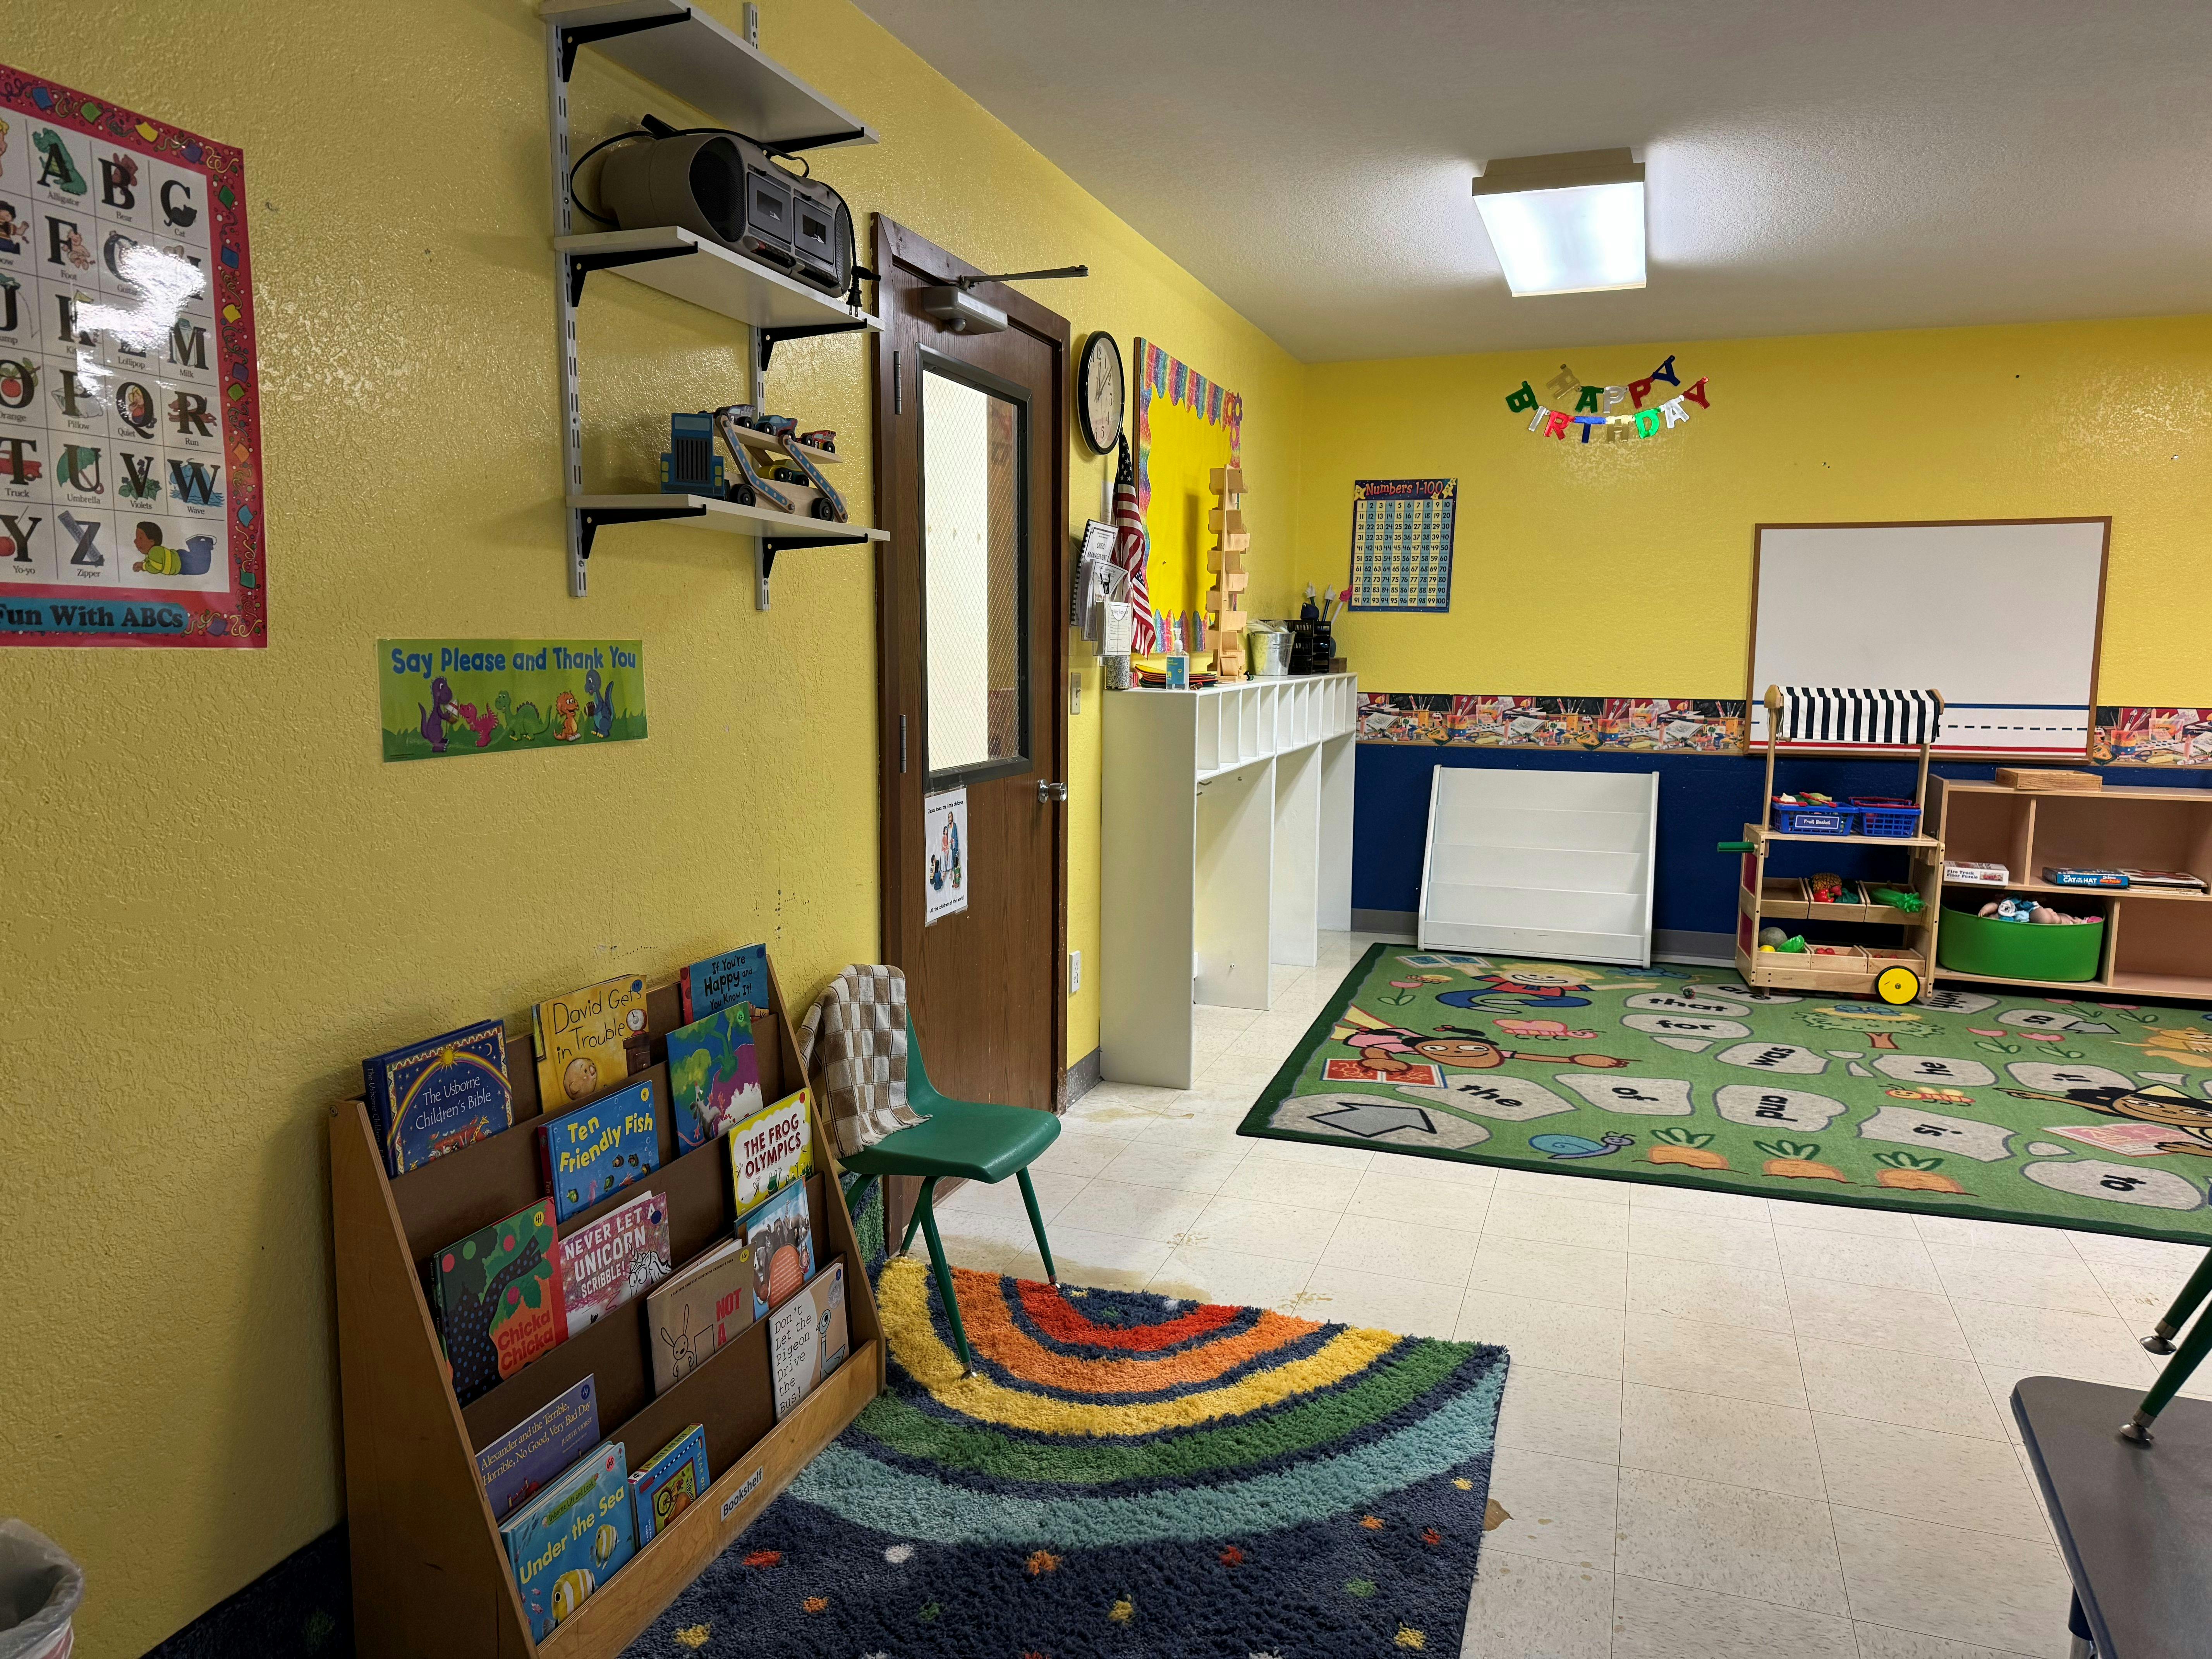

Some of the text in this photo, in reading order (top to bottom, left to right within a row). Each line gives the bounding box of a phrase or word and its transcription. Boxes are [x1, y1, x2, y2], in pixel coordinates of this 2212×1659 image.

[37, 143, 73, 187] A
[48, 191, 80, 206] Alligator
[98, 158, 135, 210] B
[116, 211, 132, 222] Bear
[160, 179, 191, 227] C
[45, 215, 77, 266] F
[175, 228, 185, 237] Cat
[61, 270, 77, 280] Foot
[167, 323, 209, 370] M
[1097, 345, 1102, 361] 12
[118, 356, 146, 369] Lollipop
[180, 369, 194, 378] Milk
[59, 369, 93, 416] P
[1546, 355, 1681, 414] HAPPY
[117, 382, 155, 440] Q
[174, 391, 214, 438] R
[1106, 411, 1109, 425] 4
[1505, 376, 1710, 444] BIRTHDAY
[68, 420, 89, 430] Pillow
[118, 428, 136, 438] Quiet
[1101, 426, 1104, 439] 5
[185, 438, 199, 447] Run
[0, 437, 37, 486] T
[64, 444, 101, 491] U
[120, 452, 154, 498] V
[788, 472, 792, 480] 2
[5, 488, 29, 498] Truck
[167, 459, 221, 504] W
[1365, 481, 1443, 496] Numbers 1-100
[67, 493, 101, 505] Umbrella
[130, 500, 153, 510] Violets
[187, 506, 205, 515] Wave
[0, 514, 42, 562] Y
[70, 520, 101, 565] Z
[13, 565, 35, 575] Yo-yo
[77, 568, 101, 578] Zipper
[50, 604, 184, 629] With ABCs
[391, 645, 636, 679] Say Please and Thank You
[712, 955, 746, 975] If You're
[704, 967, 752, 997] Happy and
[1717, 986, 1772, 1001] are
[709, 983, 752, 1011] You Know It!
[1648, 997, 1728, 1013] that
[553, 991, 603, 1035] David
[1655, 1020, 1716, 1032] for
[569, 1017, 625, 1050] Trouble
[556, 1046, 572, 1064] in
[1747, 1046, 1796, 1067] was
[1914, 1061, 1955, 1076] he
[422, 1075, 480, 1106] The Usborne
[2052, 1072, 2094, 1082] it
[415, 1088, 491, 1130] Children's Bible
[1456, 1084, 1523, 1108] the
[1611, 1087, 1659, 1103] of
[1755, 1094, 1798, 1123] and
[558, 1112, 654, 1174] Friendly Fish
[567, 1115, 600, 1144] Ten
[744, 1112, 799, 1160] THE FROG
[1913, 1123, 1963, 1136] is
[744, 1132, 802, 1179] OLYMPICS
[2100, 1174, 2147, 1192] to
[565, 1225, 611, 1261] NEVER
[617, 1209, 642, 1234] LET
[574, 1226, 647, 1283] UNICORN
[581, 1262, 626, 1299] SCRIBBLE!
[716, 1288, 742, 1319] NOT
[498, 1309, 551, 1351] Chicka
[775, 1305, 803, 1333] Don't
[776, 1314, 812, 1351] Let the
[500, 1326, 554, 1371] Chicka
[718, 1322, 726, 1346] A
[776, 1332, 811, 1367] Pigeon
[777, 1350, 806, 1382] Drive
[779, 1377, 796, 1397] the
[779, 1386, 802, 1415] Bus!
[481, 1402, 569, 1471] Alexander and the Terrible,
[482, 1459, 515, 1486] Horrible,
[515, 1448, 527, 1463] No
[528, 1432, 549, 1453] Good,
[549, 1421, 564, 1436] Very
[565, 1409, 577, 1426] Bad
[578, 1401, 591, 1417] Day
[562, 1429, 577, 1446] JUDITH
[549, 1504, 567, 1522] Usborne
[567, 1496, 575, 1507] Lift
[583, 1483, 594, 1492] Look
[723, 1468, 763, 1516] Bookshelf
[520, 1486, 624, 1584] Under the Sea
